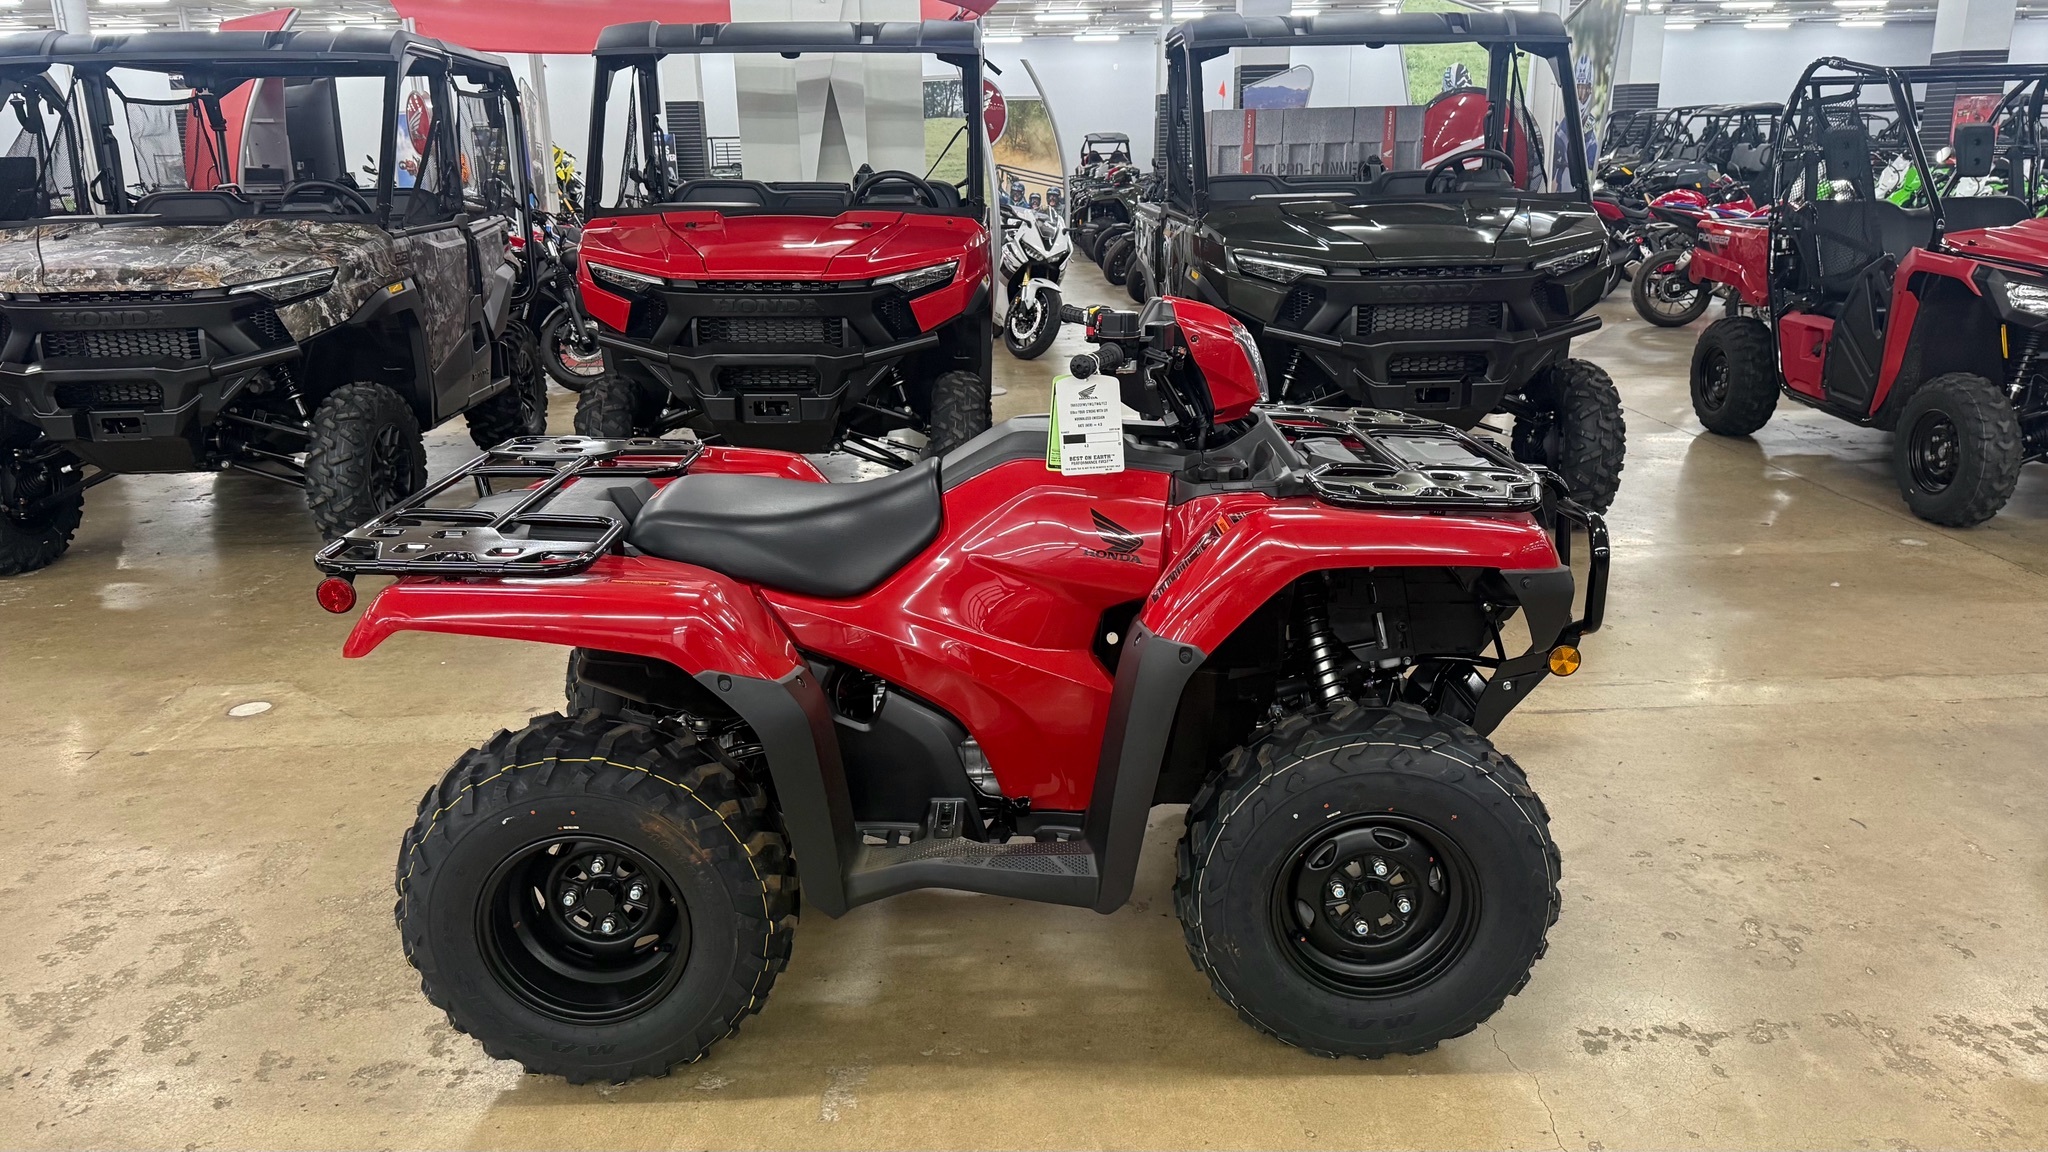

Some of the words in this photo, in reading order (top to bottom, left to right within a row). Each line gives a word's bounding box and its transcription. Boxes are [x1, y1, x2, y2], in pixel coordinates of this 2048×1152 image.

[1698, 232, 1730, 245] PIONEER
[1378, 284, 1486, 298] HONDA
[712, 298, 824, 313] HONDA
[52, 310, 176, 326] HONDA
[1083, 550, 1143, 564] HONDA
